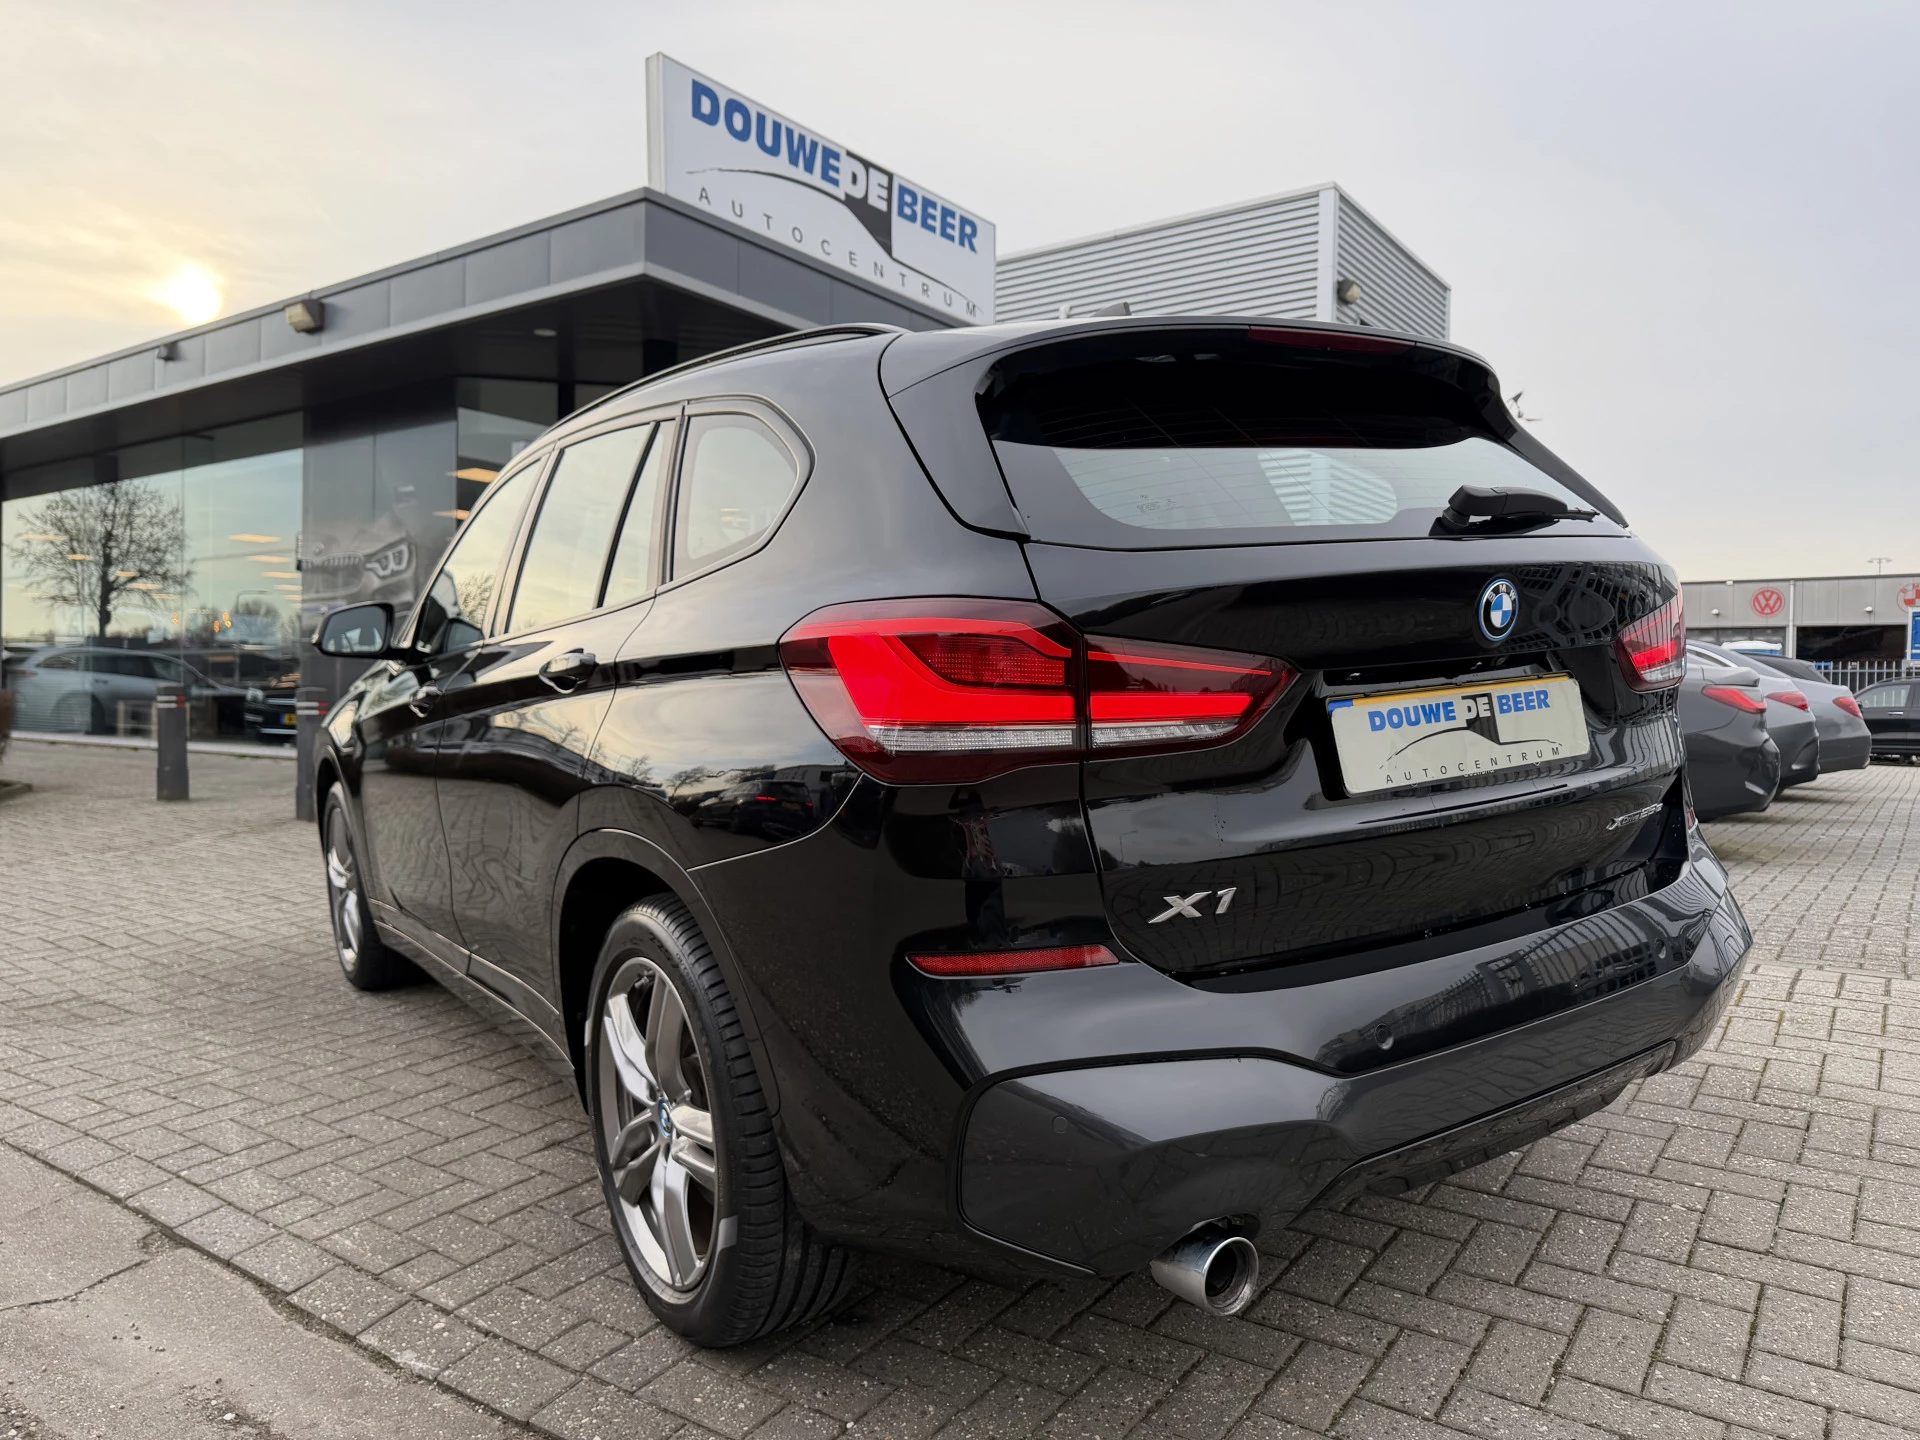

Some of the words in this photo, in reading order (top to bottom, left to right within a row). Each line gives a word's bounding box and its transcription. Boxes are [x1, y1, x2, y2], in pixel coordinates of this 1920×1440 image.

[691, 78, 842, 188] DOUWE
[843, 153, 889, 213] DE
[896, 183, 979, 254] BEER
[698, 186, 977, 319] AUTOCENTRUM
[1487, 583, 1516, 603] BMW
[1367, 700, 1457, 732] DOUWE
[1462, 698, 1491, 721] DE
[1496, 689, 1551, 715] BEER
[1385, 746, 1561, 785] AUTOCENTRUM
[1147, 886, 1237, 924] X1
